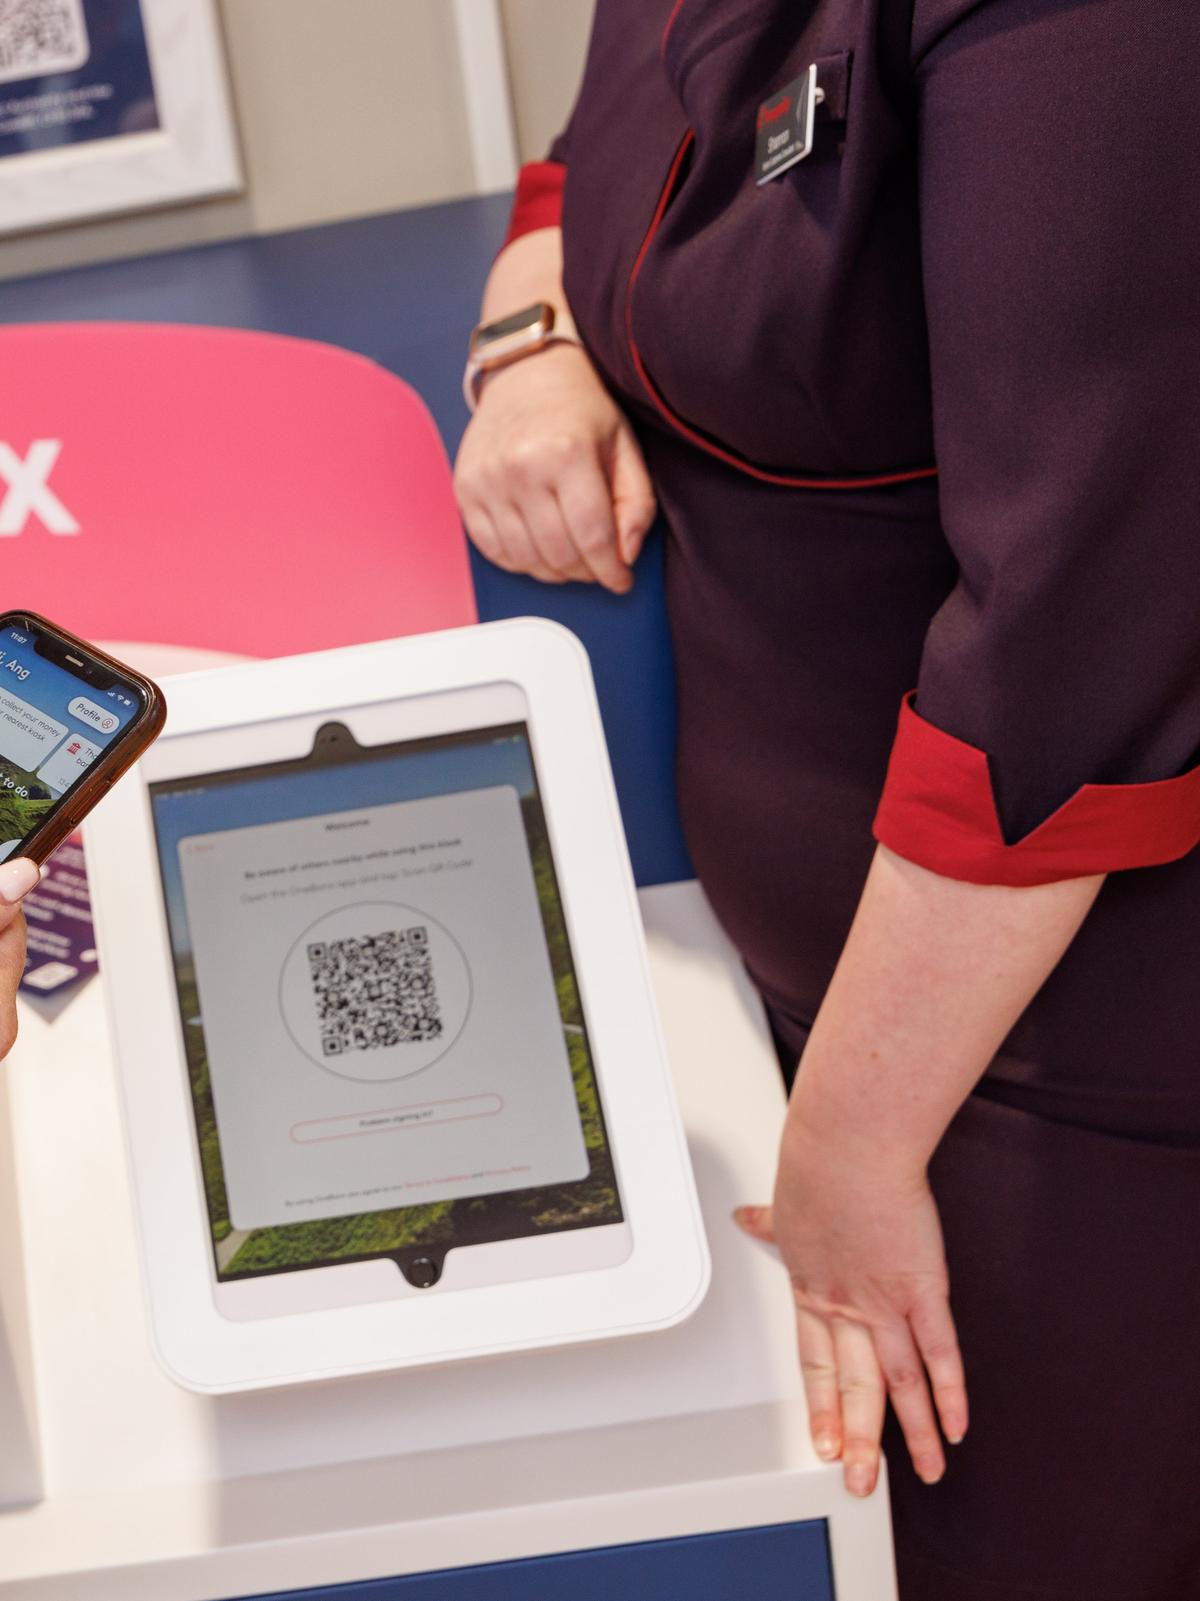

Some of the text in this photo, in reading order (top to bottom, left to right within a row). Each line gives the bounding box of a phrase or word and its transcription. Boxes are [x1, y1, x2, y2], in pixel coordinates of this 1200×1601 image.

[10, 632, 27, 644] 11:07
[5, 660, 31, 680] Ang
[1, 698, 24, 715] collect
[22, 710, 38, 724] your
[38, 721, 60, 738] money
[76, 703, 100, 722] Profile
[3, 713, 29, 732] nearest
[28, 728, 45, 742] kiosk
[2, 773, 16, 790] to
[14, 782, 30, 798] do
[324, 817, 371, 833] Welcome
[258, 866, 287, 877] aware
[288, 862, 299, 873] of
[301, 858, 329, 871] others
[392, 846, 416, 857] using
